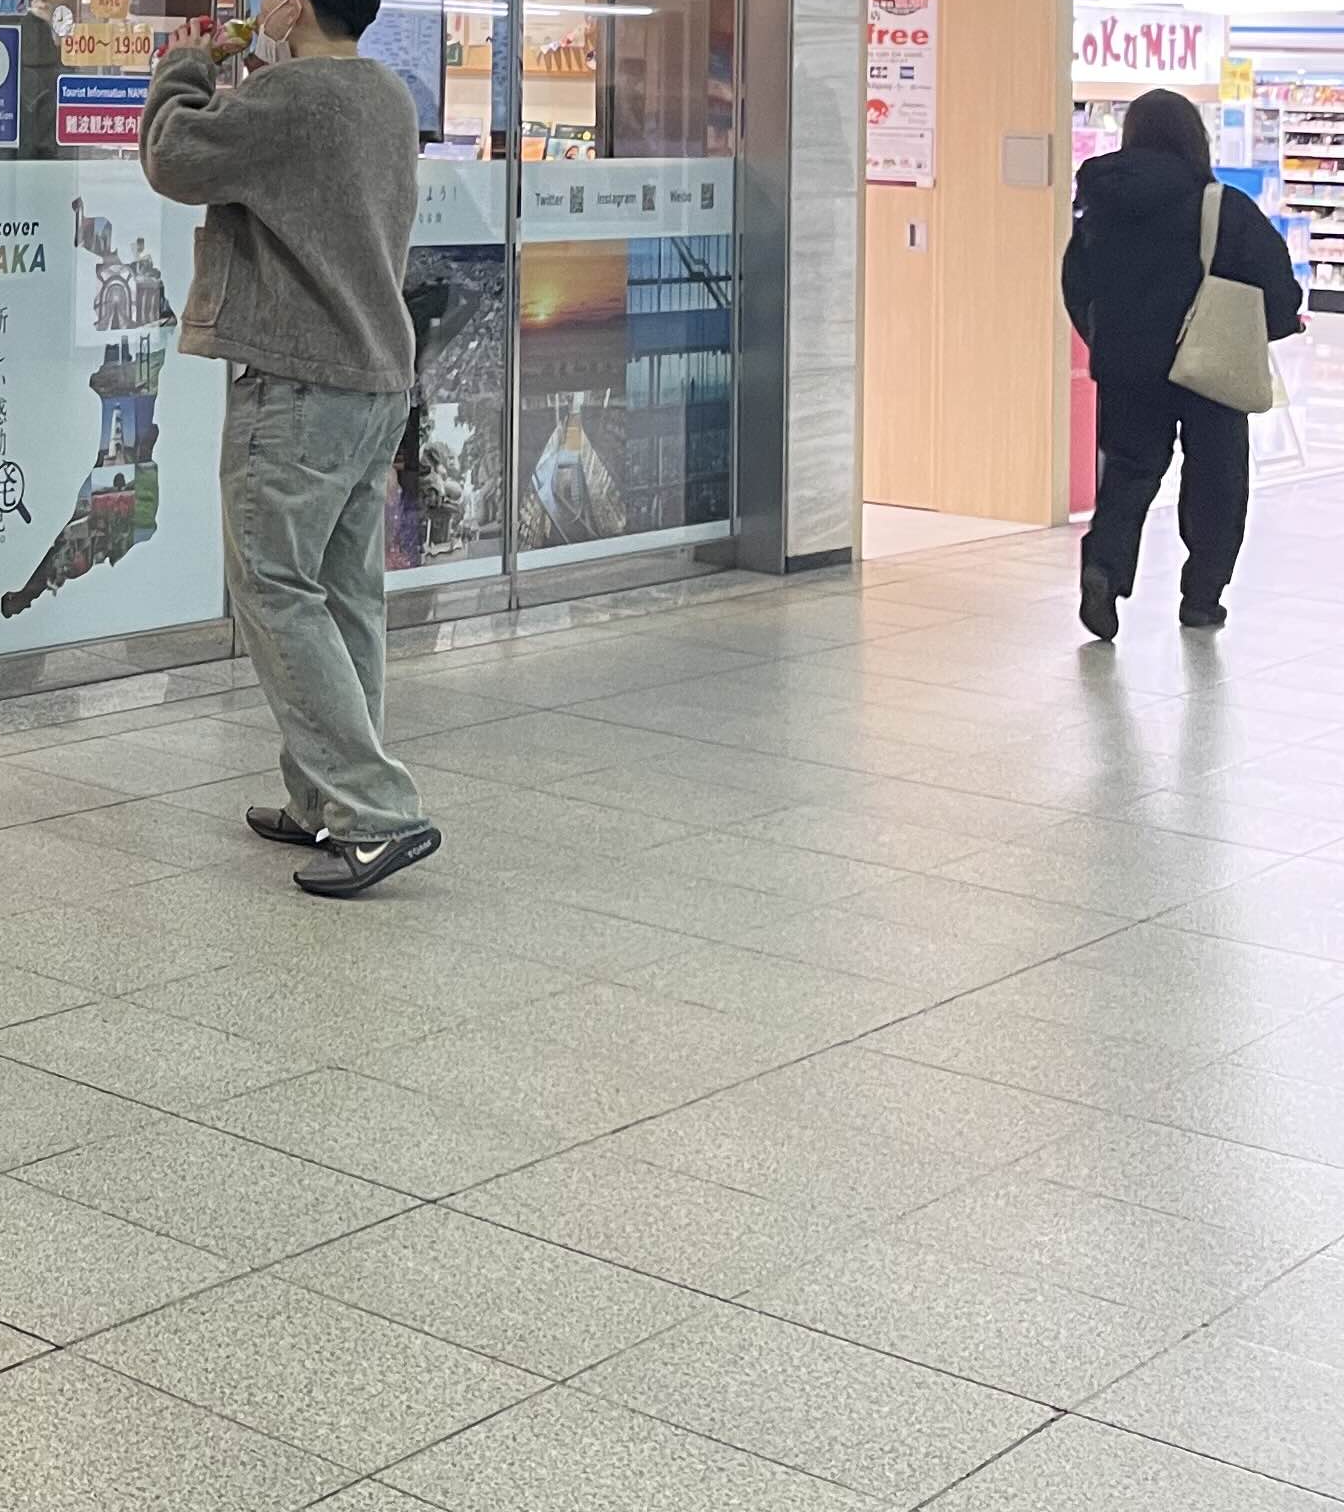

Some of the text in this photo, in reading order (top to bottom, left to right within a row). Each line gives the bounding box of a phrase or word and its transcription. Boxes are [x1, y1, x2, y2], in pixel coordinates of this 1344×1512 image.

[62, 86, 148, 98] Tourist Information NAMB
[65, 115, 141, 134] 難波観光案内
[535, 190, 693, 208] Twitter Instagram Weibo
